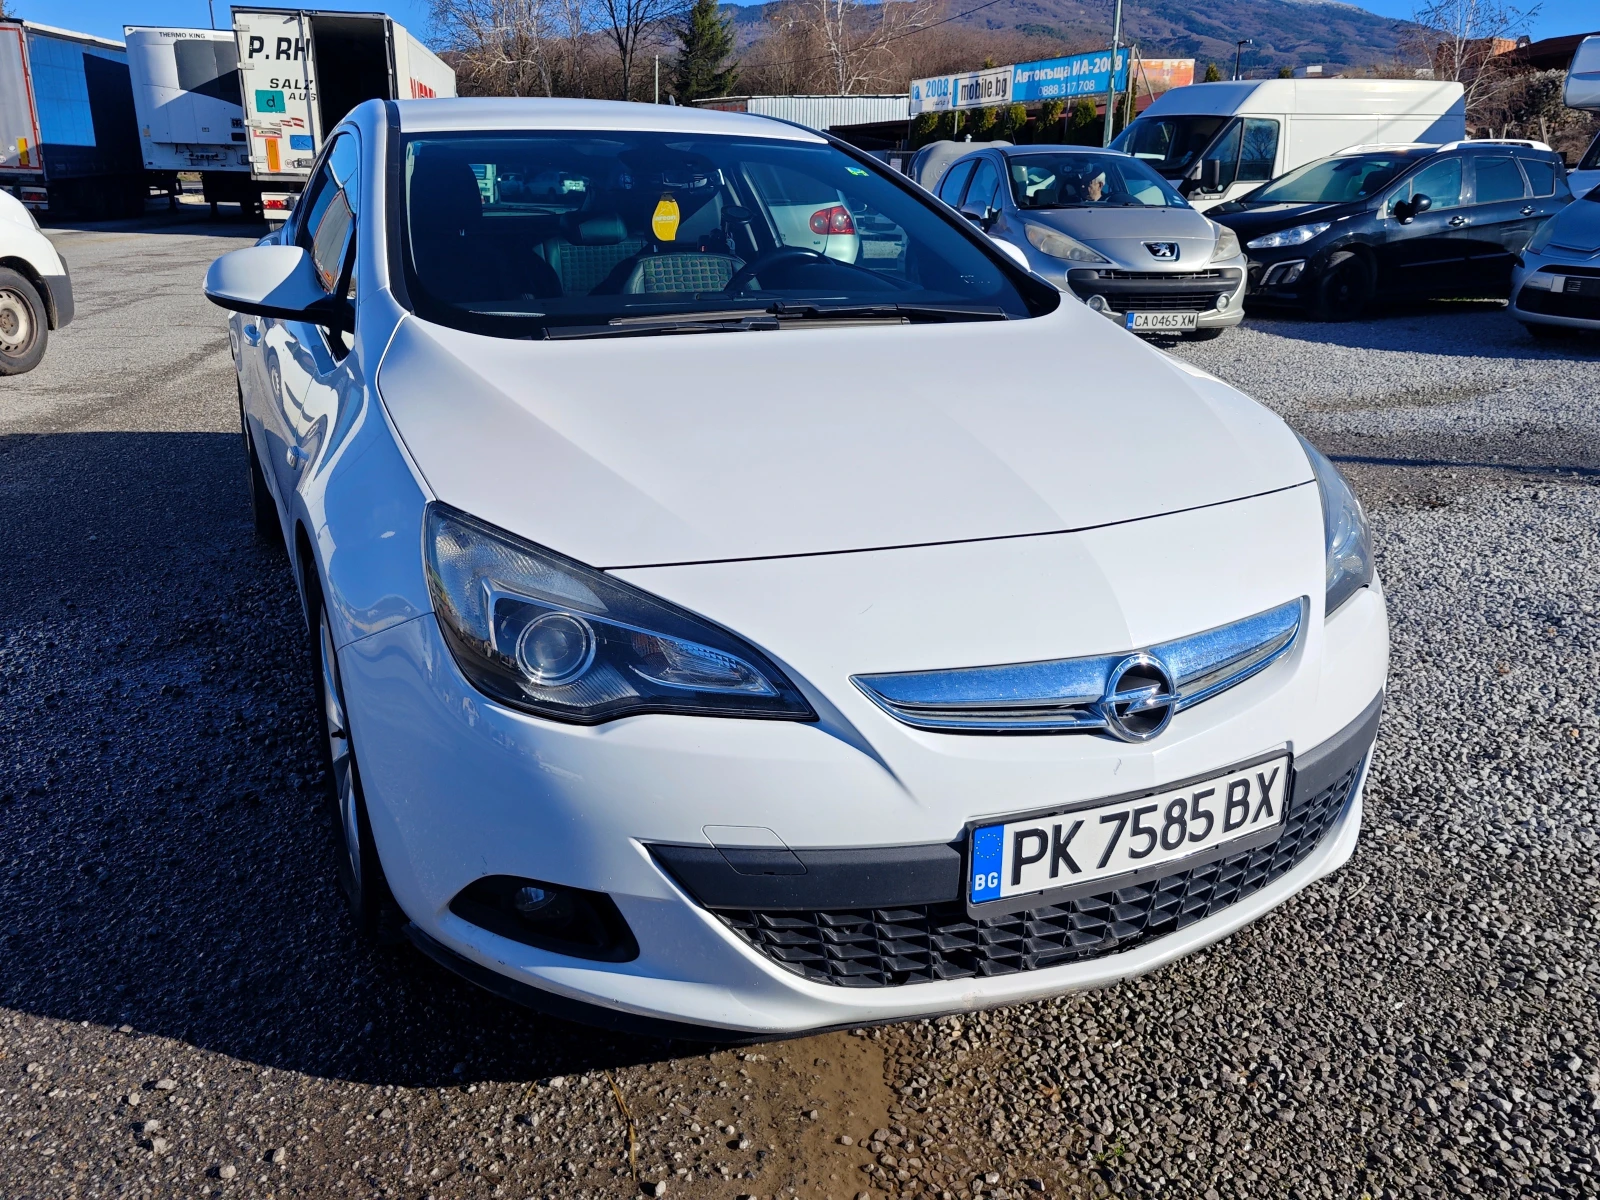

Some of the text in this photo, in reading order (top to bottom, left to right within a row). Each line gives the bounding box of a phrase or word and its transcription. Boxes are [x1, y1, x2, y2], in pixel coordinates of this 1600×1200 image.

[159, 31, 187, 39] THERMO
[1014, 64, 1071, 84] Автокъща
[960, 76, 1008, 101] mobile.bg
[1037, 79, 1096, 97] 0888 317 708
[1134, 315, 1196, 327] CA 0465 XM
[1010, 765, 1281, 887] PK 7585 BX
[974, 871, 999, 891] BG
